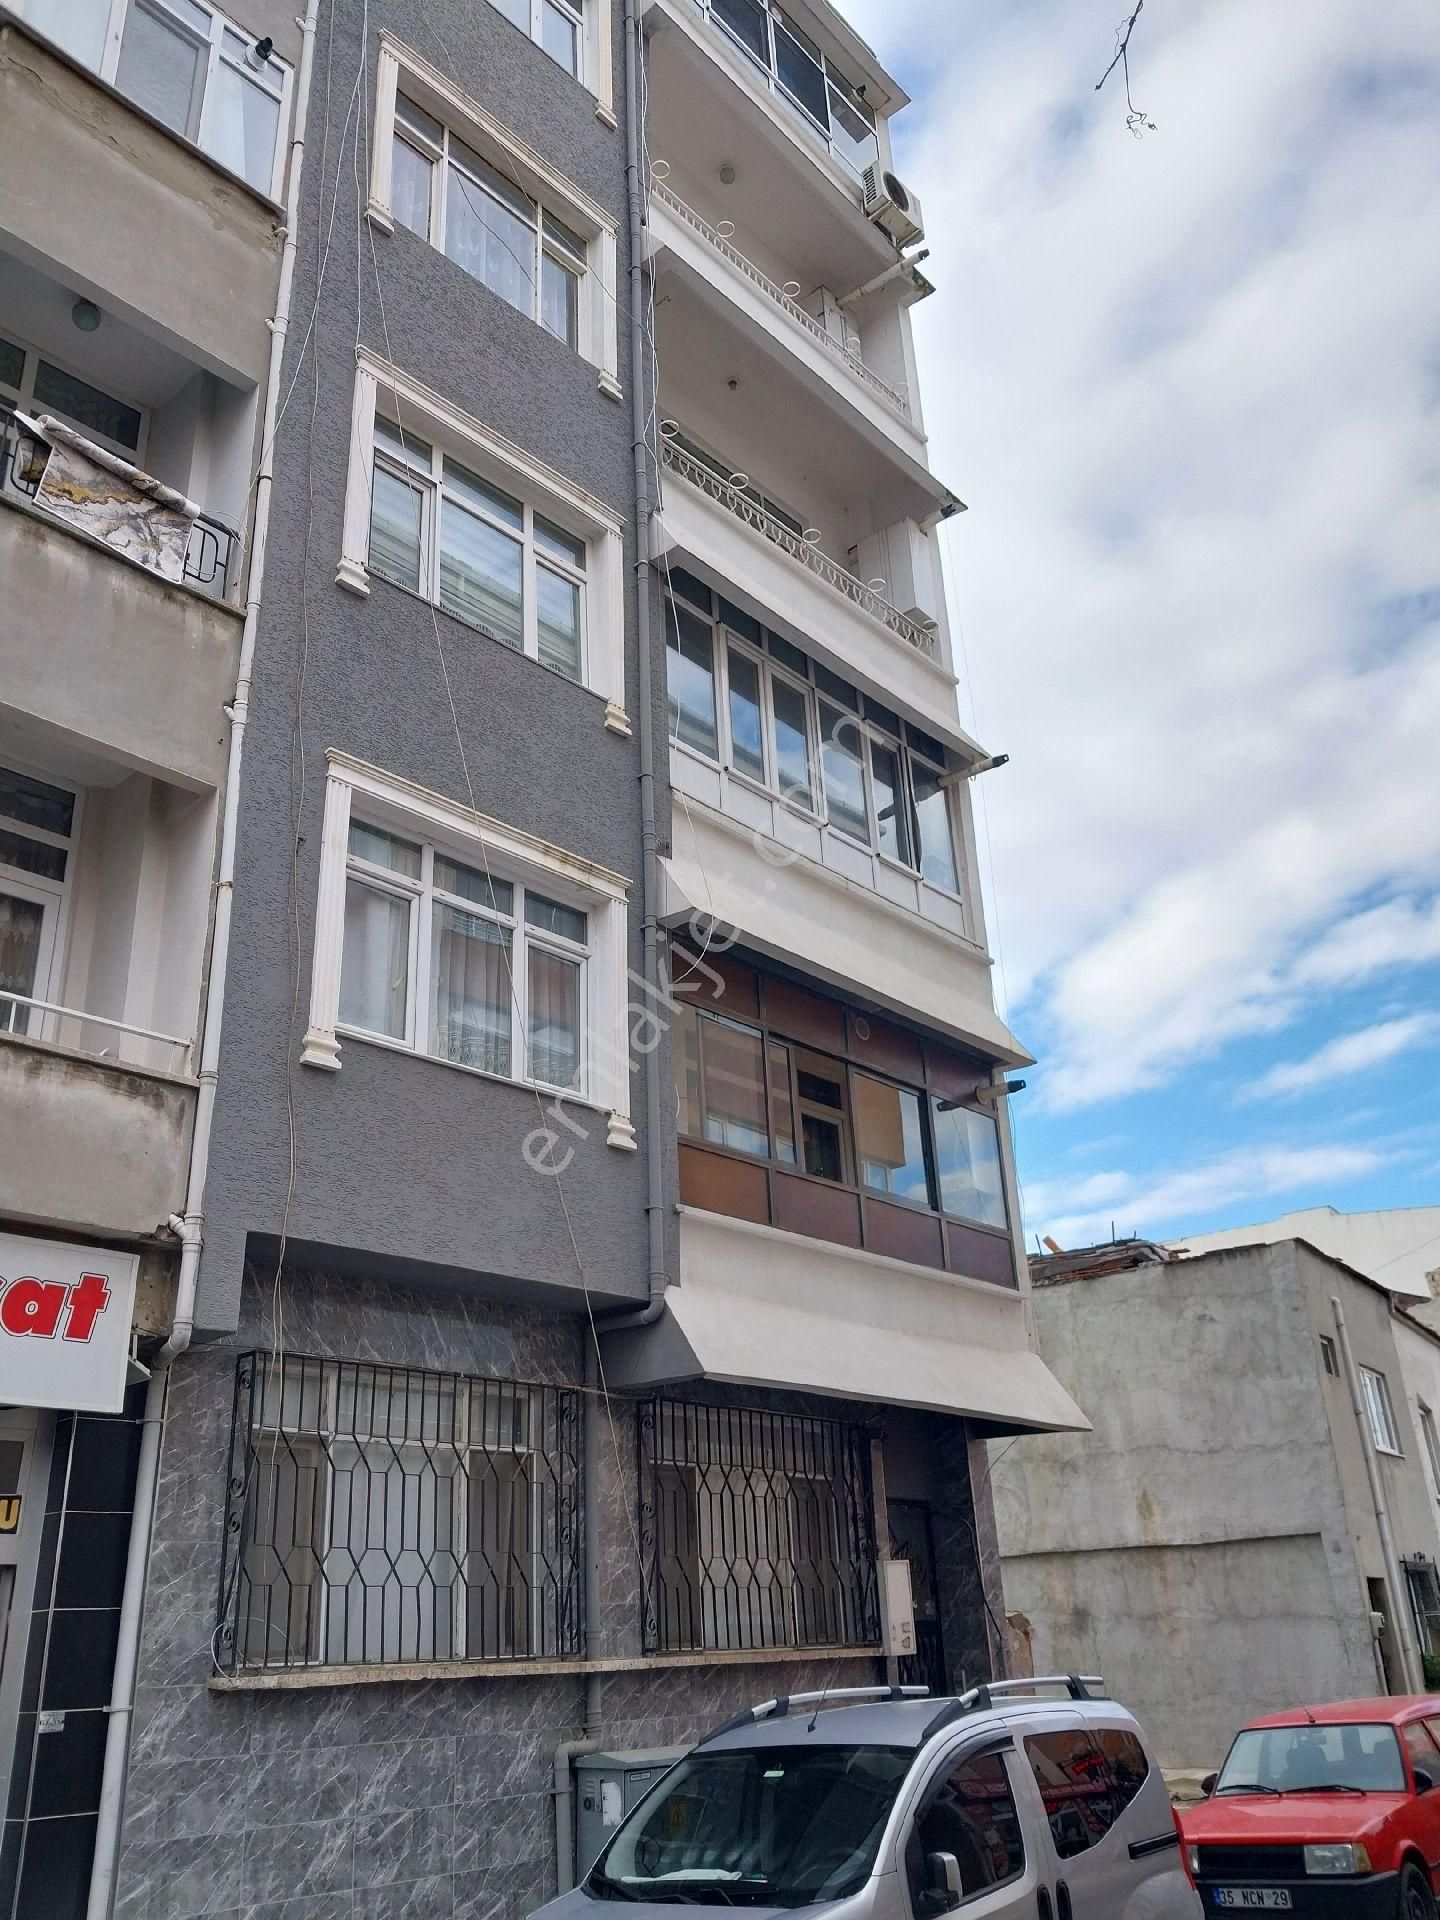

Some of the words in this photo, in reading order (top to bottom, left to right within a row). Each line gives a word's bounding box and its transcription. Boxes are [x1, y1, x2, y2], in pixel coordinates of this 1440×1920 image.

[0, 1272, 111, 1343] at
[1220, 1890, 1234, 1905] 35
[1242, 1890, 1265, 1905] NCN
[1272, 1891, 1288, 1906] 29
